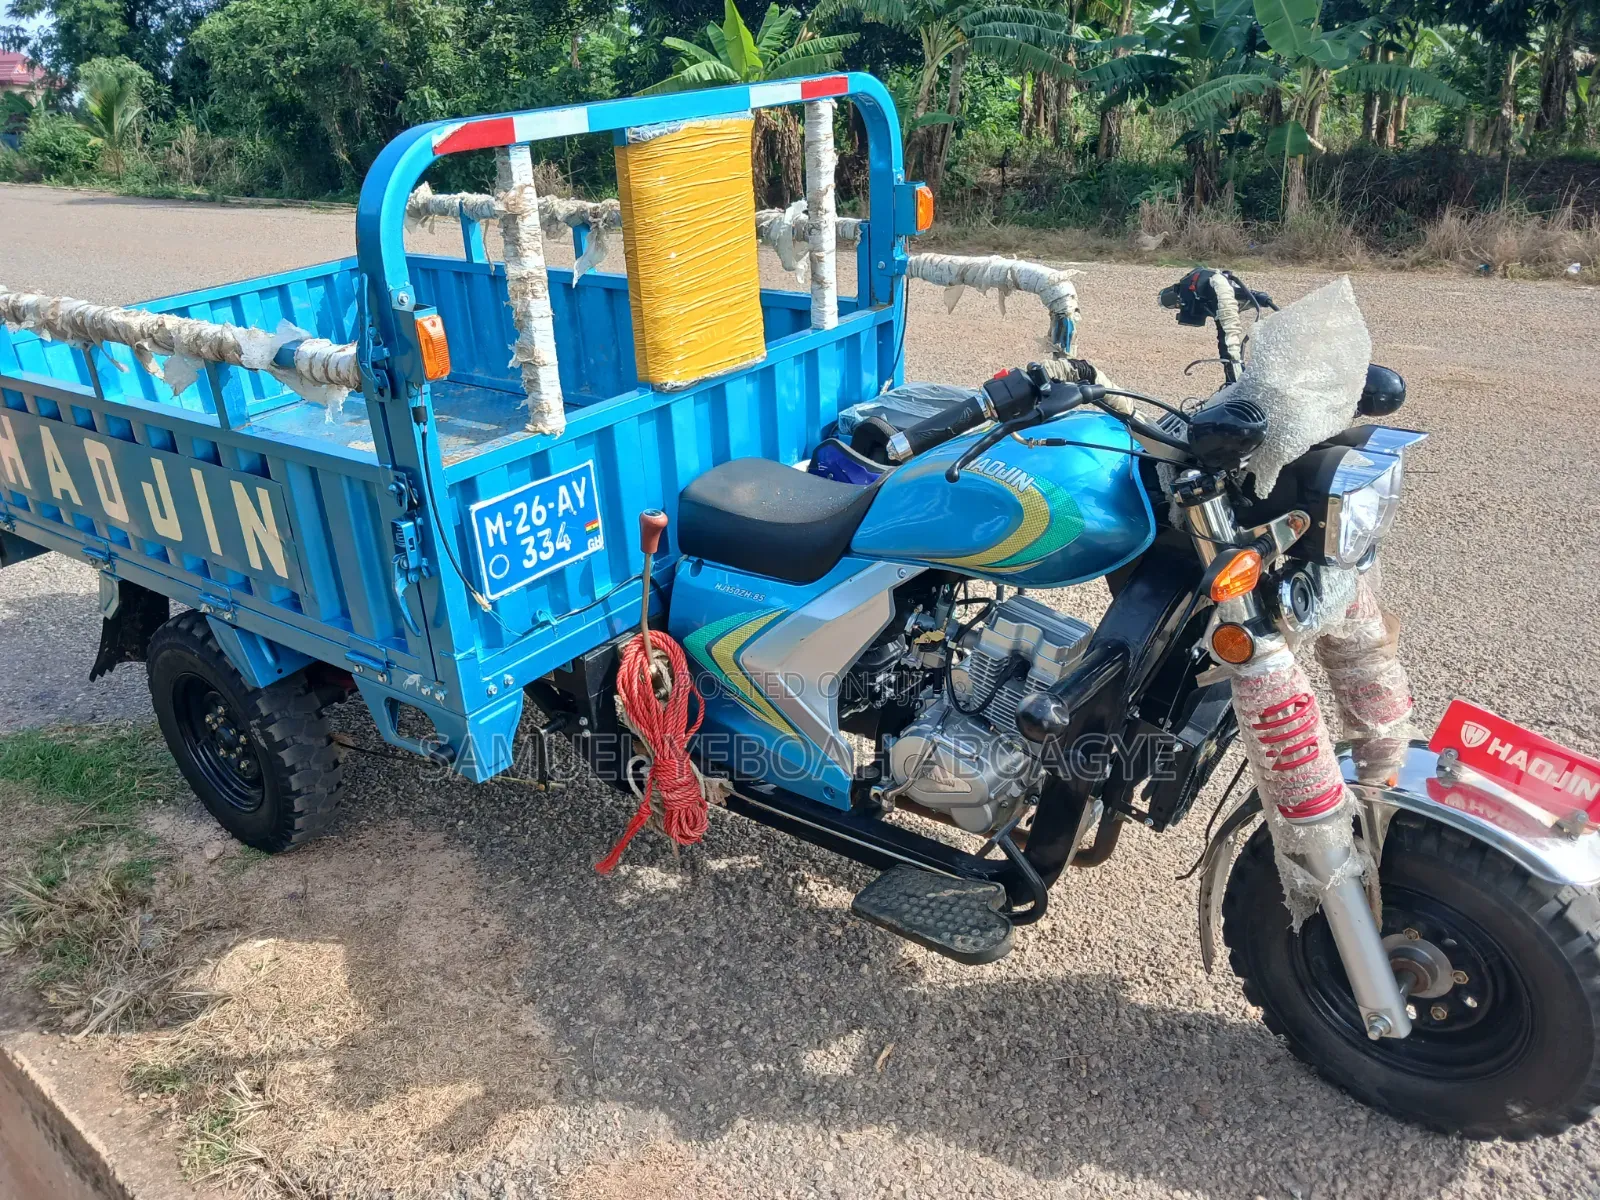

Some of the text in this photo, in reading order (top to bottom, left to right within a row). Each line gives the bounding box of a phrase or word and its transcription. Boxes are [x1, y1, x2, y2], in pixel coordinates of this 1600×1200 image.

[0, 414, 289, 579] HAOJIN
[484, 476, 587, 548] M-26-AY
[520, 521, 572, 569] 334
[1486, 737, 1600, 801] HAOJIN
